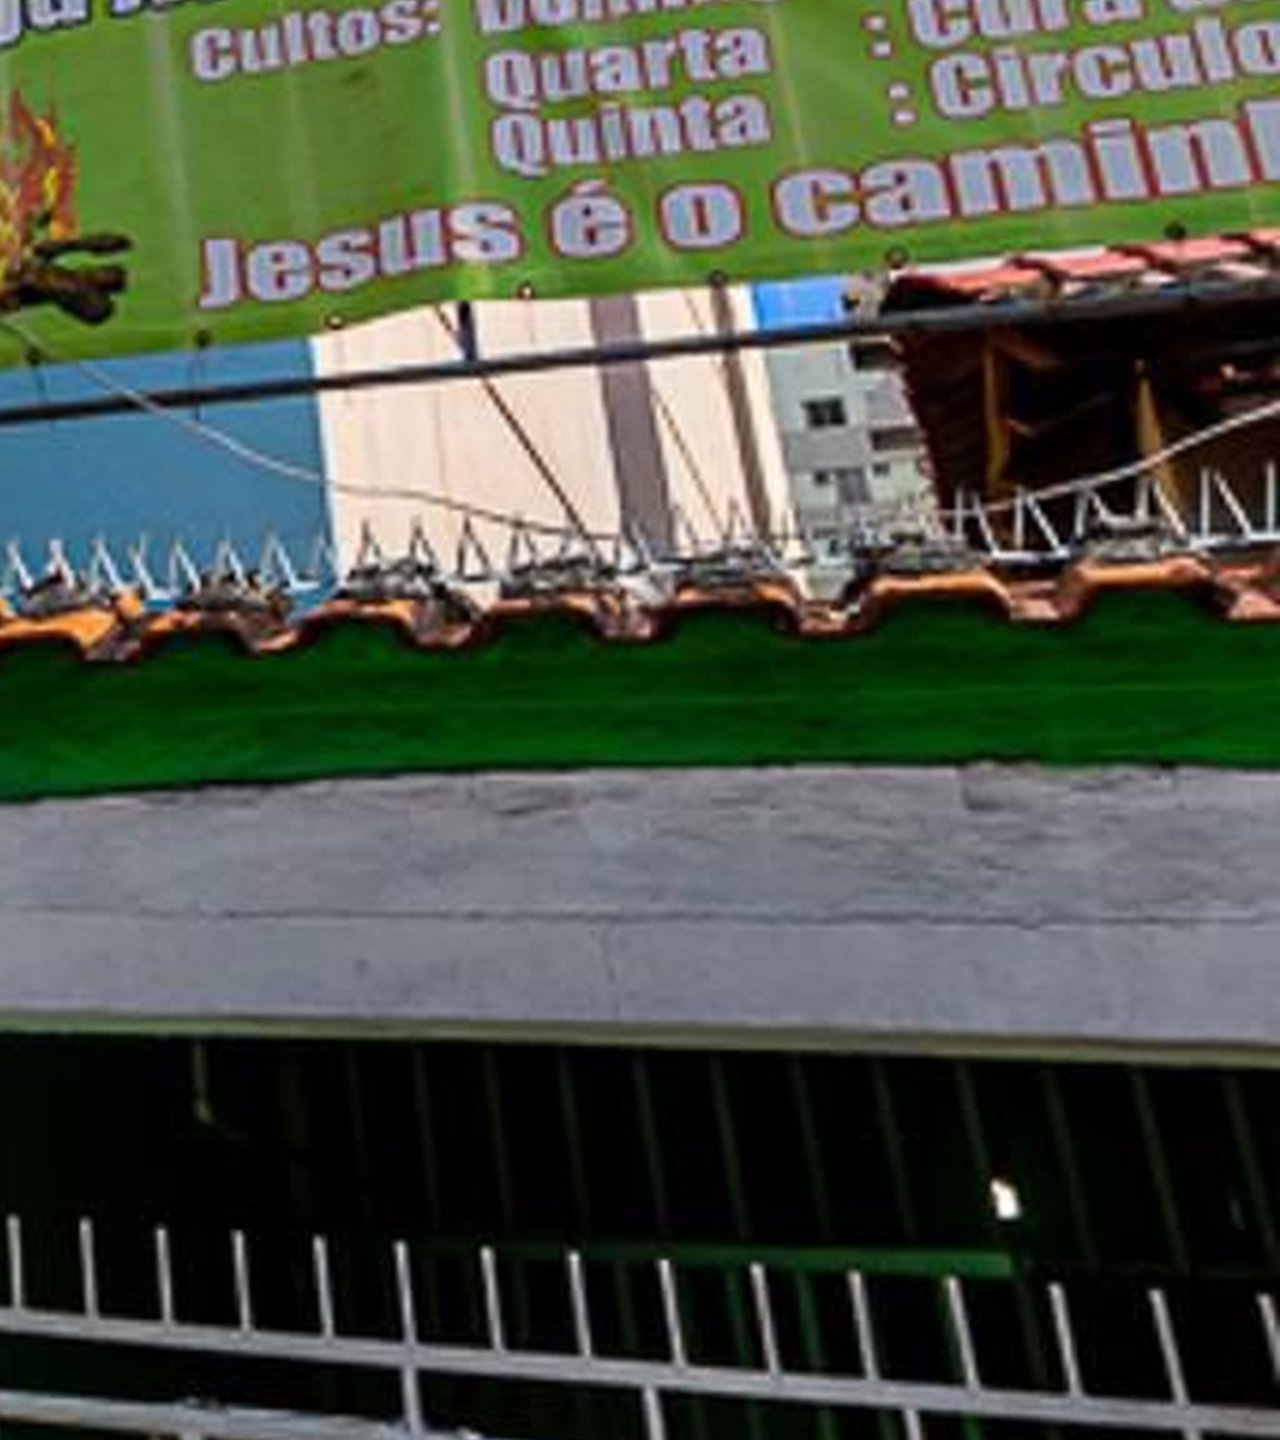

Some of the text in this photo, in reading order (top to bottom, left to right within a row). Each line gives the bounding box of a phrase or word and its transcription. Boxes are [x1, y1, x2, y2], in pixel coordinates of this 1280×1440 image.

[483, 25, 770, 110] Quarta
[491, 93, 771, 177] Quinta
[197, 200, 527, 309] Jesus
[550, 179, 633, 258] é
[658, 182, 745, 250] o
